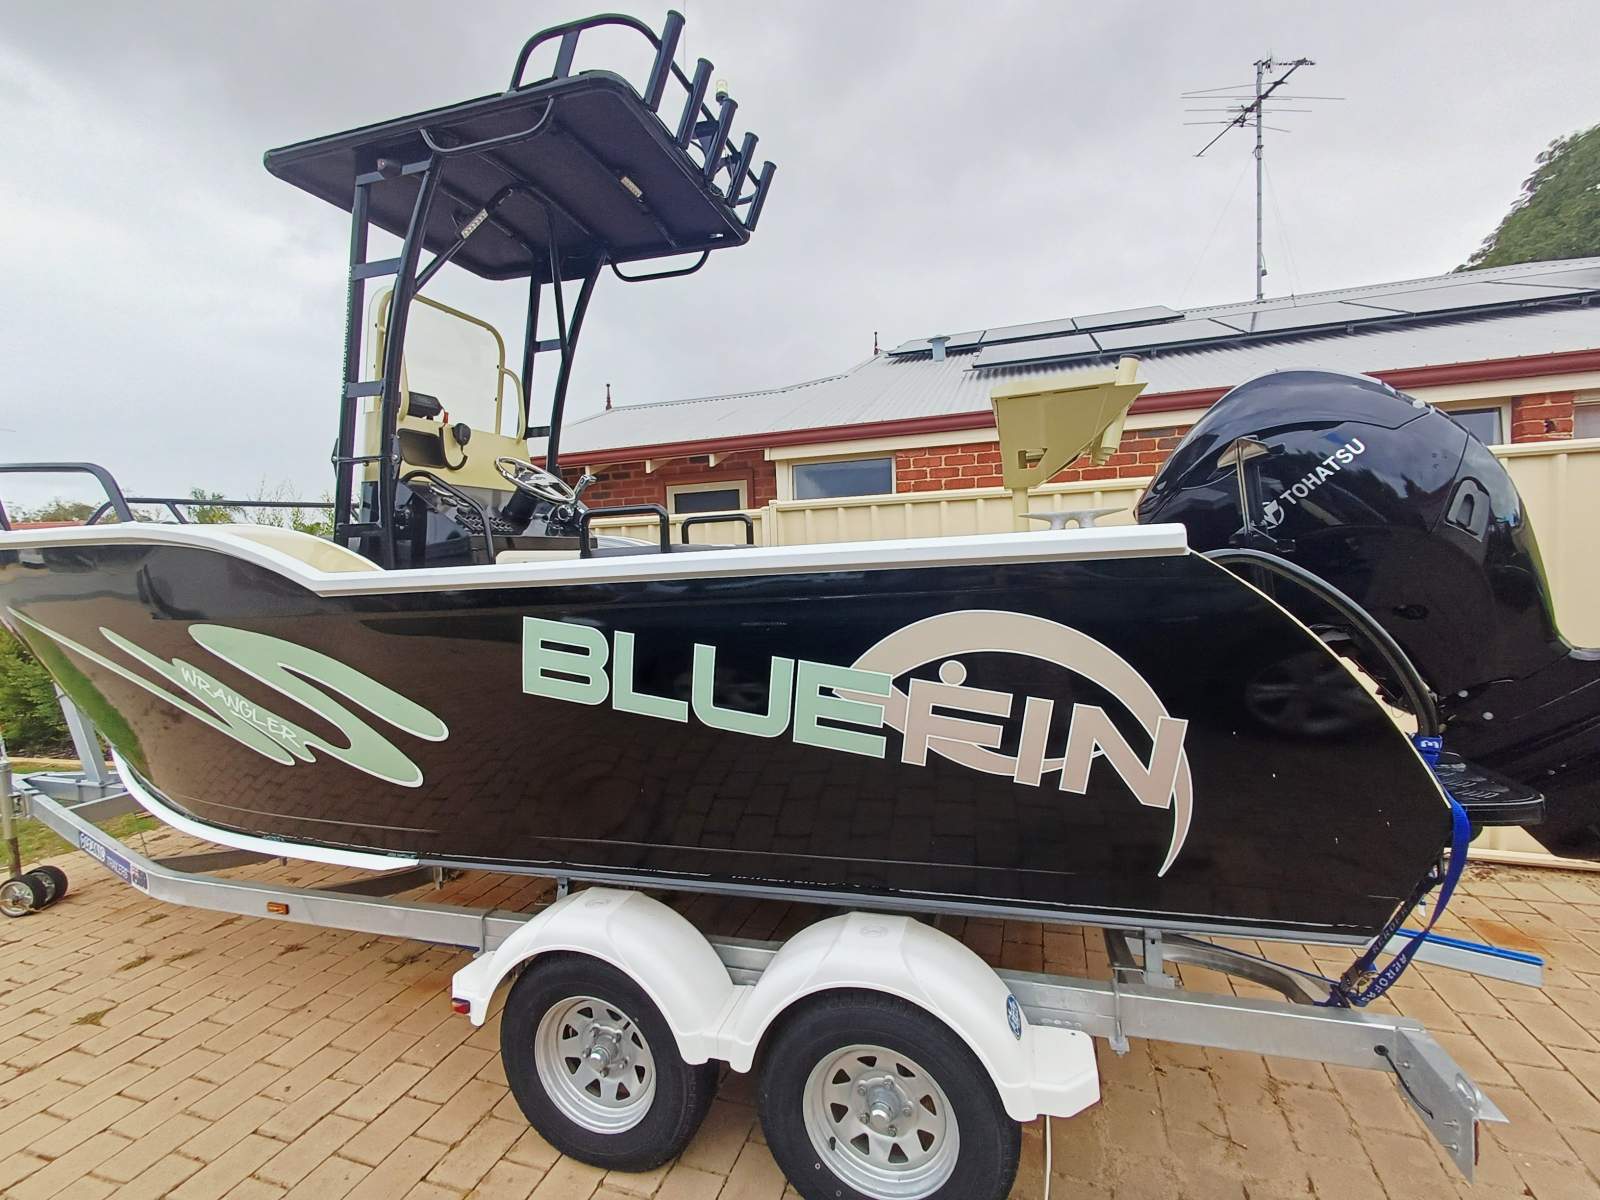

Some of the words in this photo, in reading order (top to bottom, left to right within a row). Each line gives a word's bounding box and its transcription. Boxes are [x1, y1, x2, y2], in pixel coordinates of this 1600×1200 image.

[1279, 437, 1366, 505] TOHATSU
[180, 667, 301, 747] WRANGLER
[521, 615, 1189, 809] BLUEFIN
